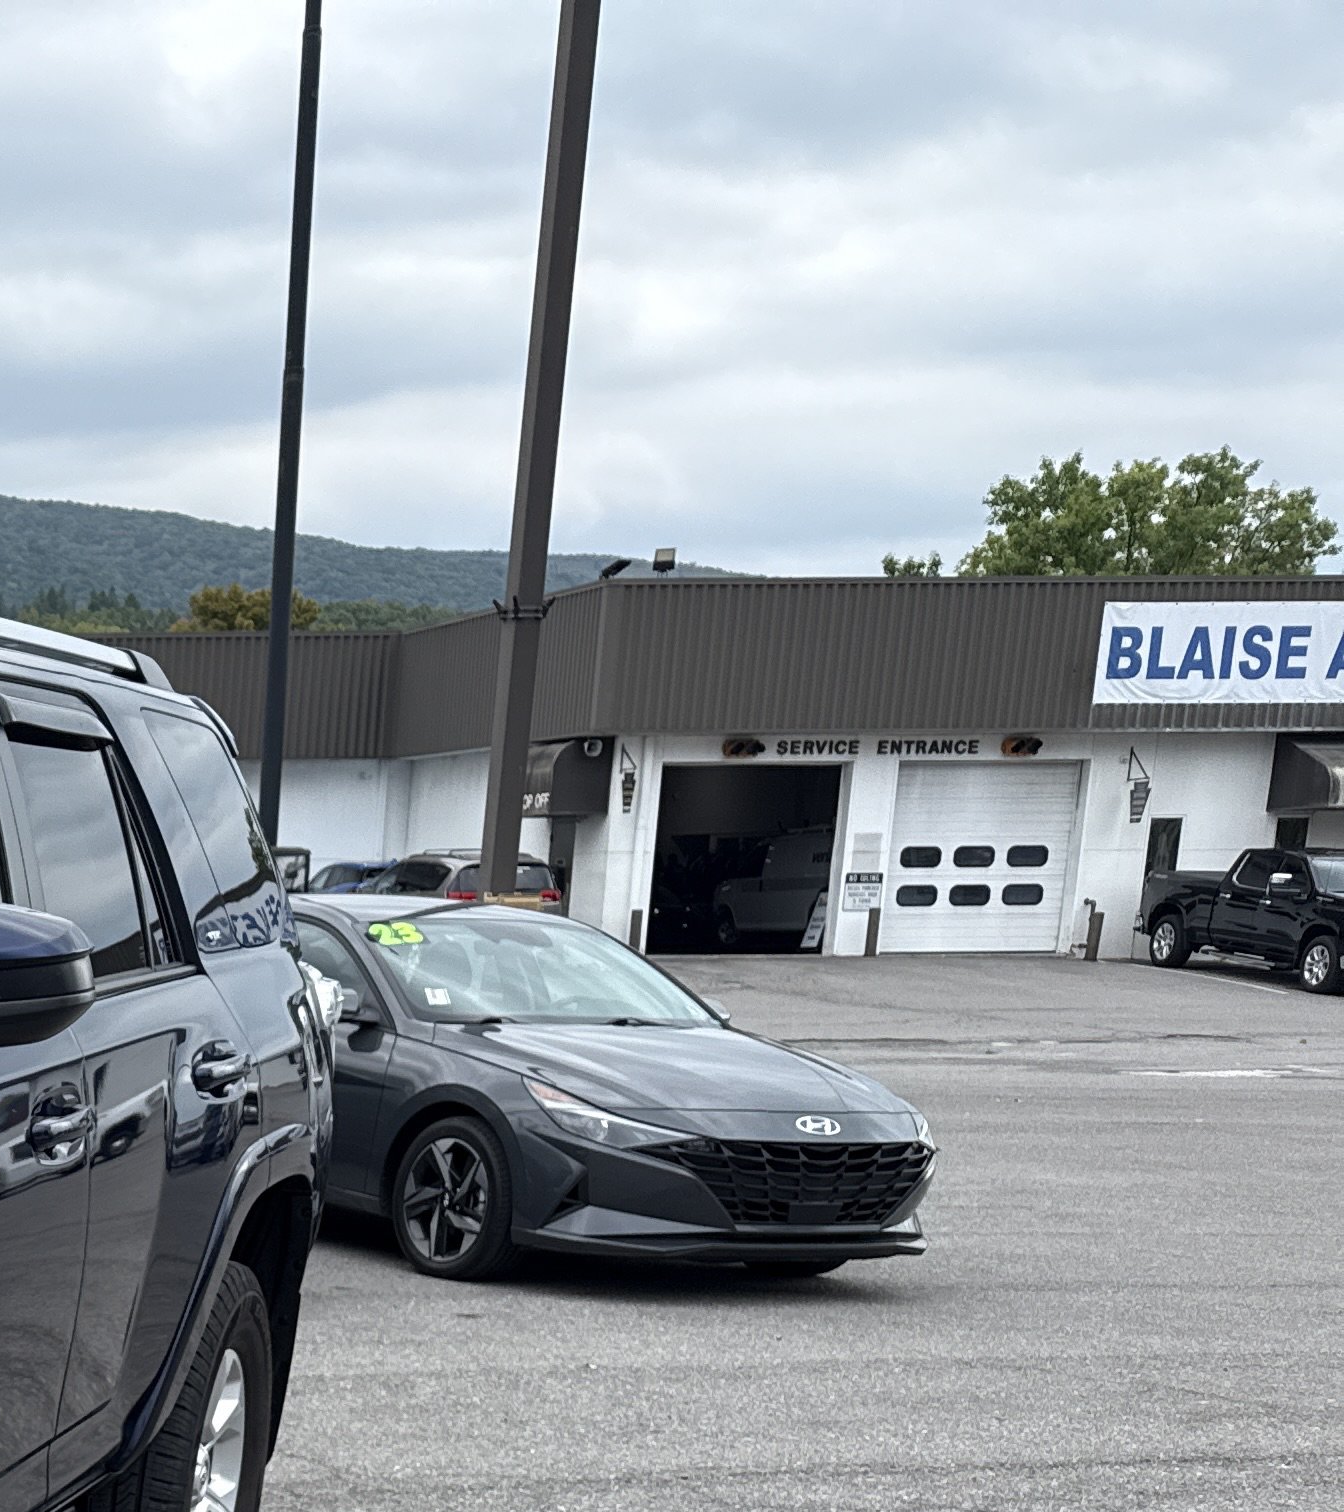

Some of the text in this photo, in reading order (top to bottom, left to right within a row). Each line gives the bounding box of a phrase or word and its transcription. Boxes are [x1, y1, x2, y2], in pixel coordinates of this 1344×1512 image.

[1105, 624, 1313, 680] BLAISE
[776, 739, 980, 755] SERVICE ENTRANCE
[368, 921, 424, 946] 23
